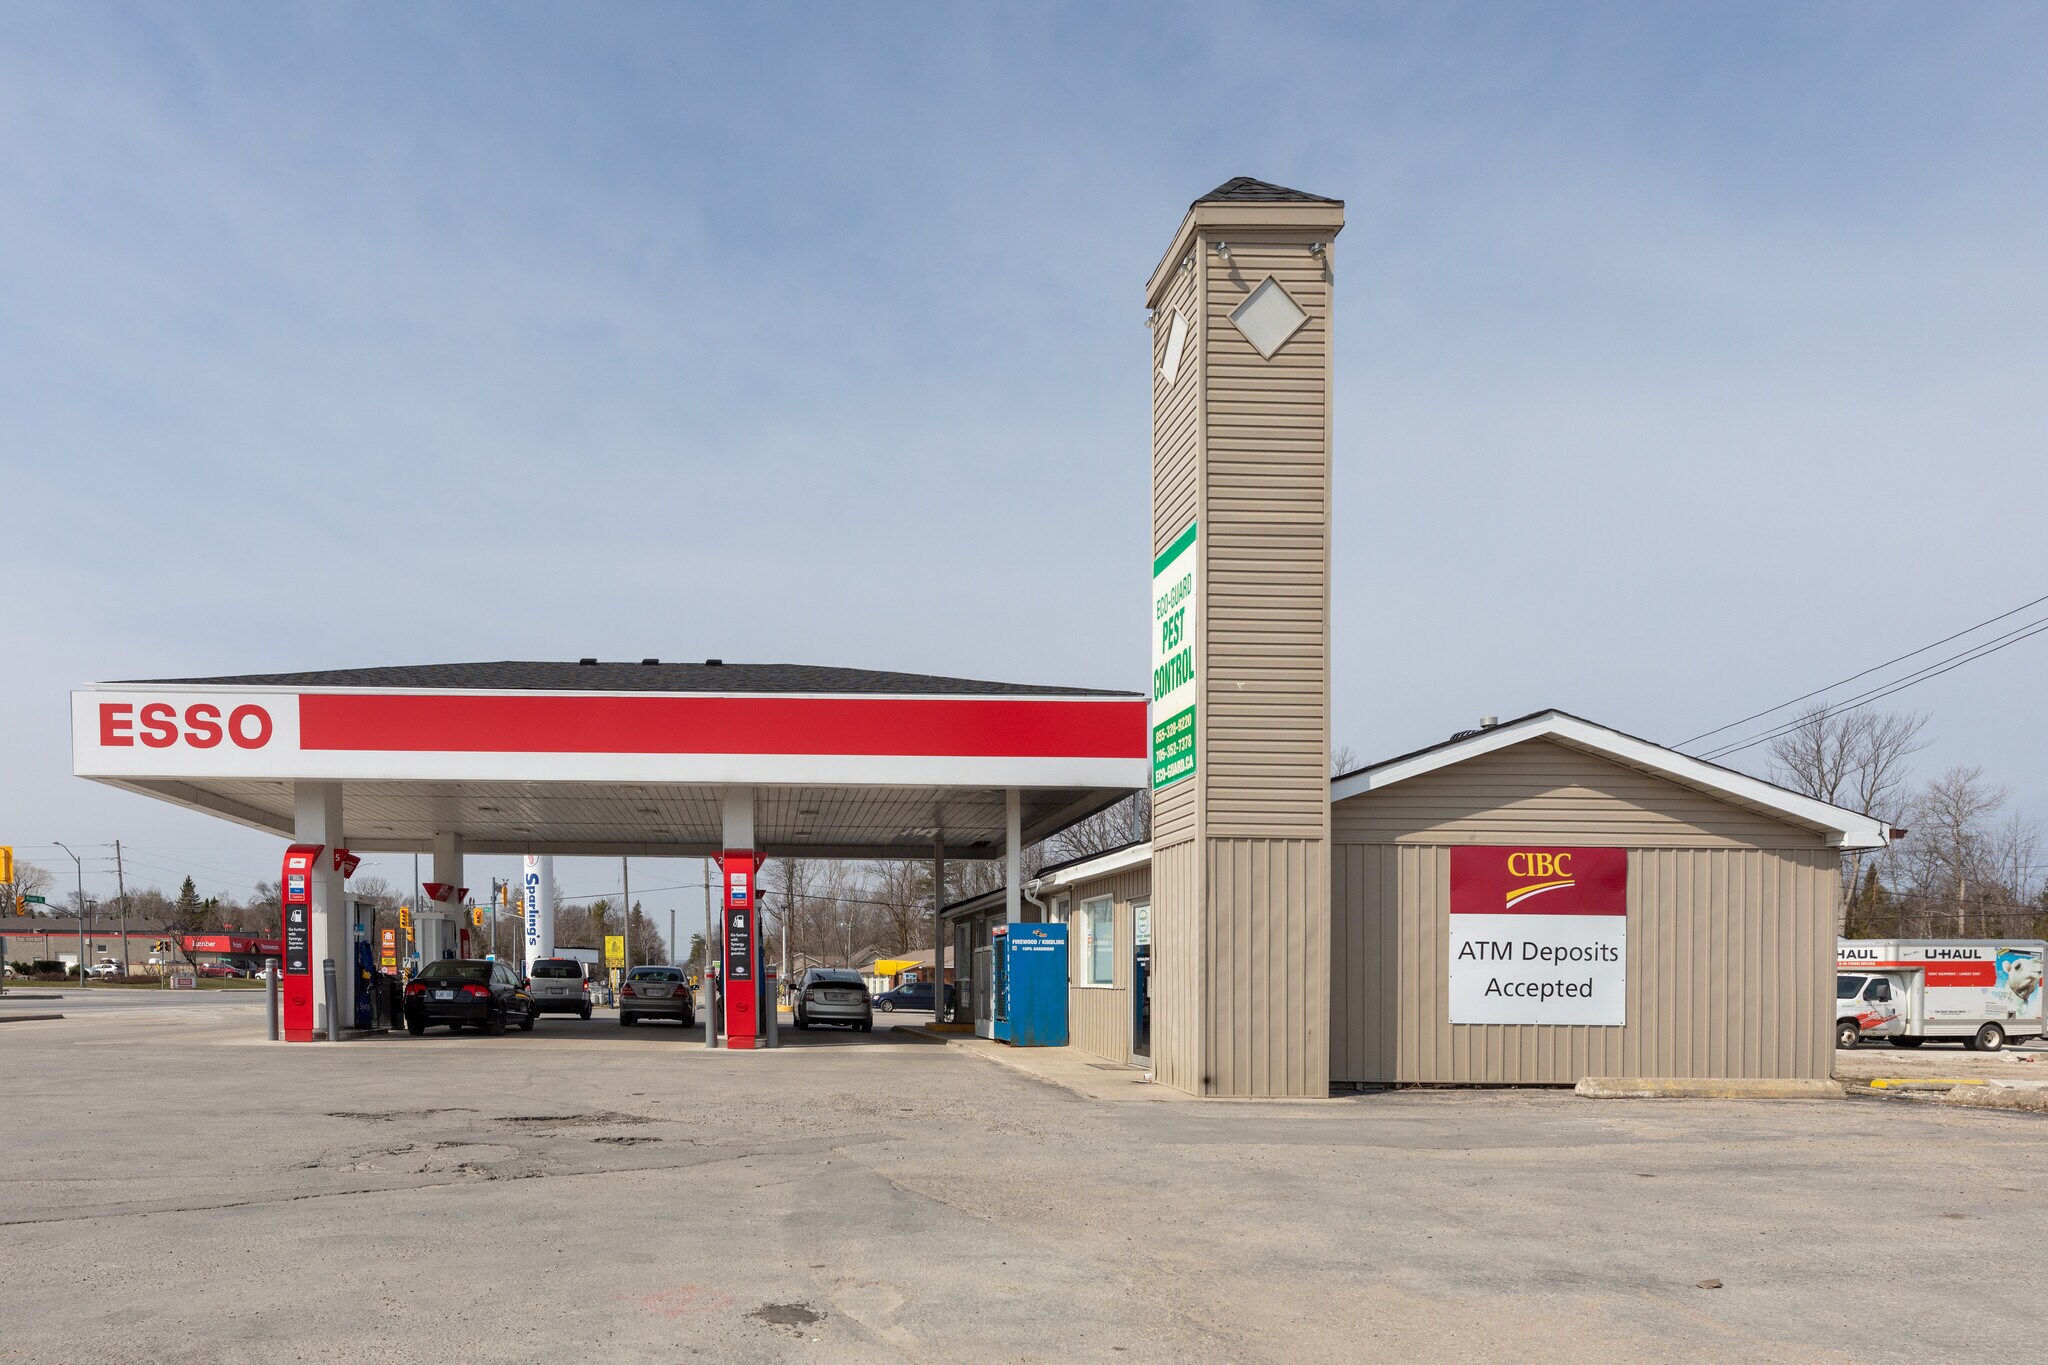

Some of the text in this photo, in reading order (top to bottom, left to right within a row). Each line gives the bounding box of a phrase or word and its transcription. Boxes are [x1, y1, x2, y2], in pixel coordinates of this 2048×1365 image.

[1156, 572, 1192, 620] ECO-GUARD
[1162, 606, 1185, 655] PEST
[1153, 645, 1195, 702] CONTROL
[99, 702, 273, 750] ESSO
[1155, 754, 1194, 783] ECO-GUARD.CA
[718, 856, 724, 864] 2
[755, 857, 760, 865] 1
[1507, 852, 1573, 877] CIBC
[525, 873, 540, 946] Sparling's
[1457, 941, 1619, 966] ATM Deposits
[1925, 949, 1982, 959] U-HAUL
[1484, 977, 1593, 1002] Accepted
